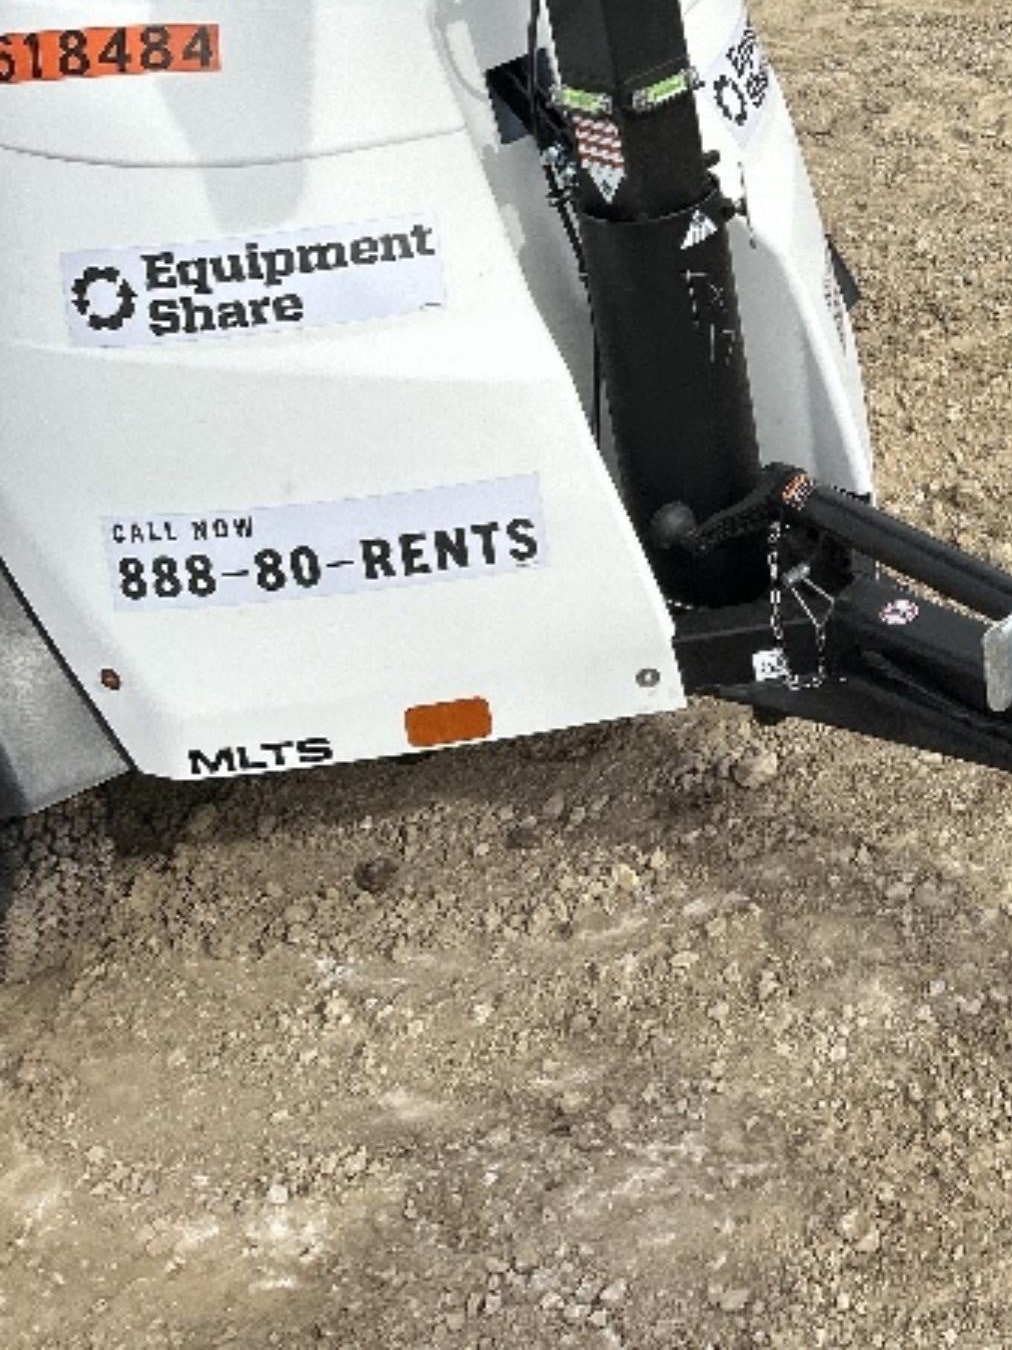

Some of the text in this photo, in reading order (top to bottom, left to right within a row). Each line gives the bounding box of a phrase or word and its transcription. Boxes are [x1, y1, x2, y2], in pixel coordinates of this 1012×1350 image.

[141, 224, 435, 294] Equipment
[149, 293, 303, 336] Share
[113, 516, 254, 544] CALL NOW
[119, 518, 538, 600] 888-80-RENTS
[188, 737, 333, 774] MLTS
